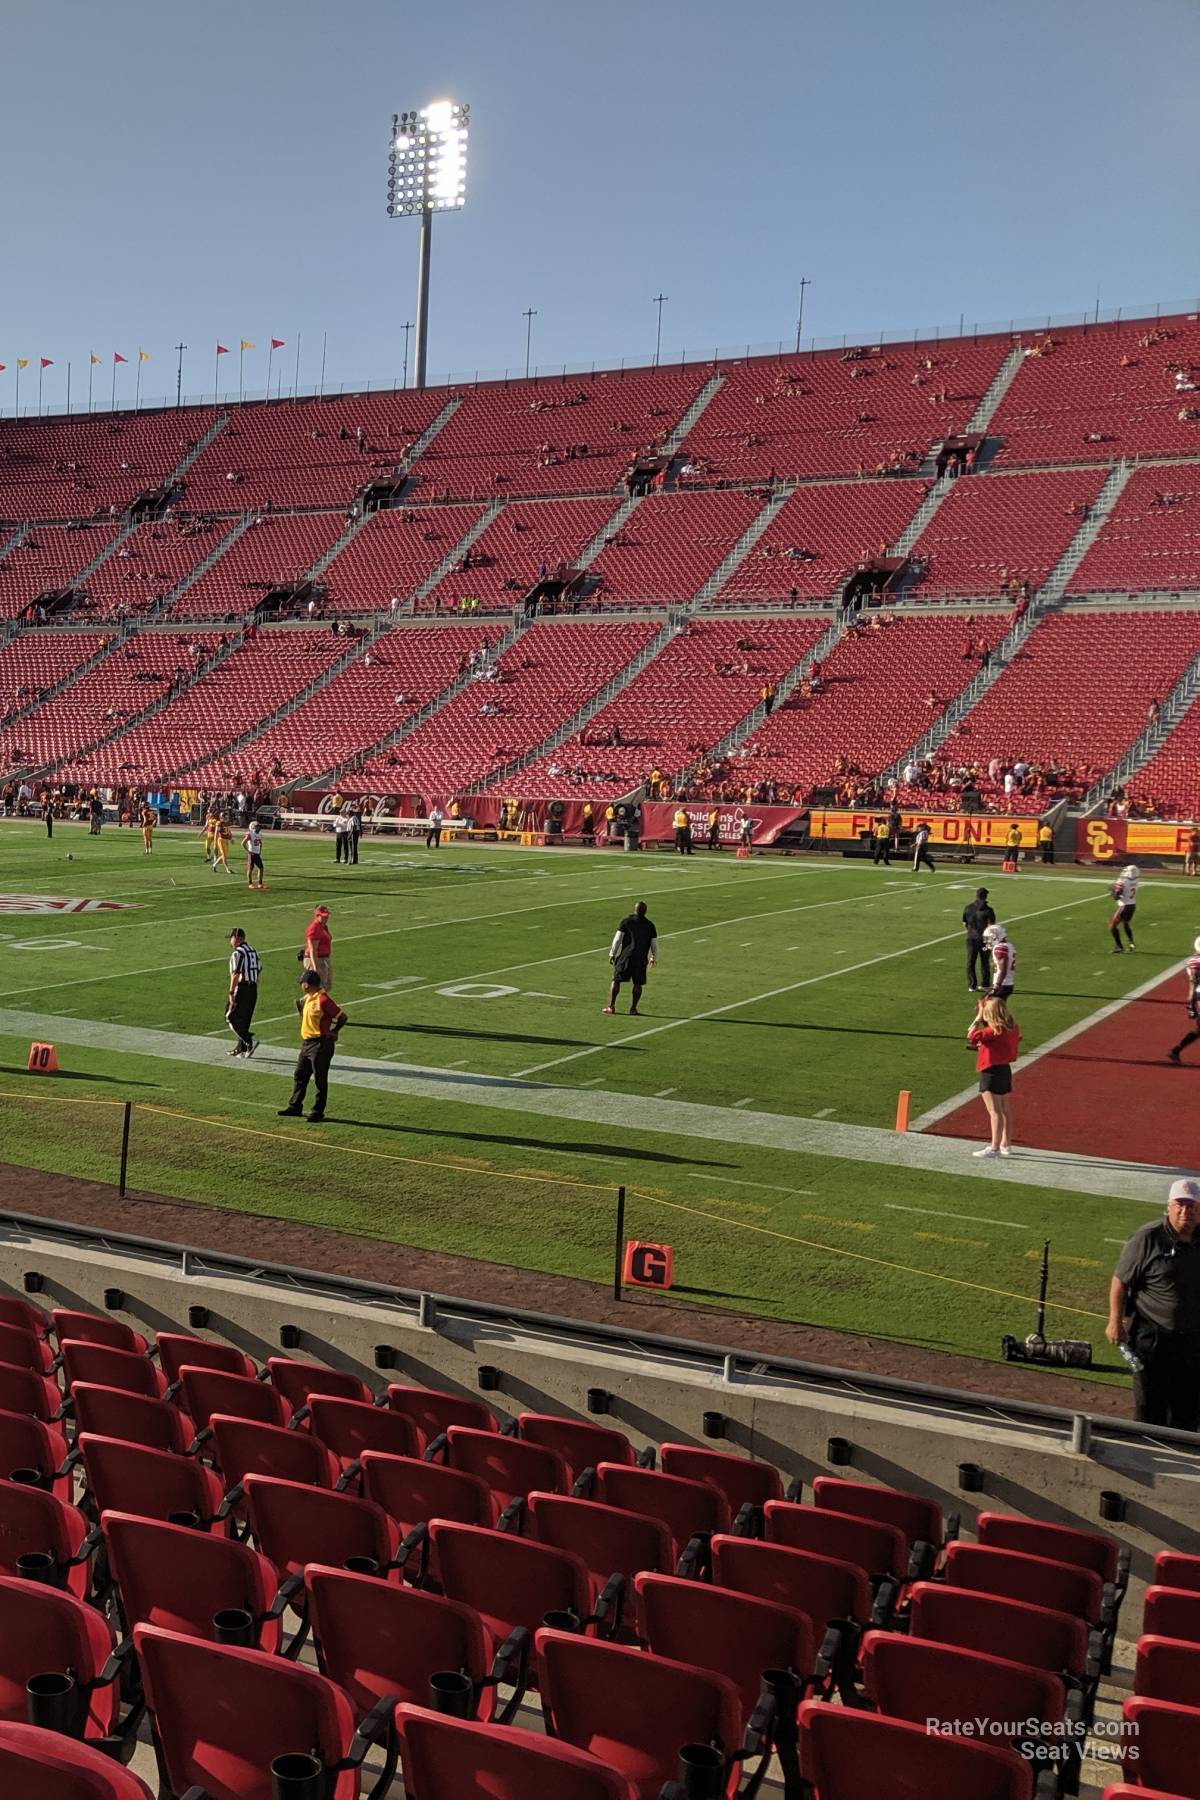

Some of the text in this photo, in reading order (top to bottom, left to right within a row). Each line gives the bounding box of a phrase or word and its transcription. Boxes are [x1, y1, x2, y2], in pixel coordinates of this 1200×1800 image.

[942, 818, 991, 842] ON!
[358, 976, 521, 999] 10
[32, 1045, 50, 1068] 10
[631, 1247, 667, 1285] G
